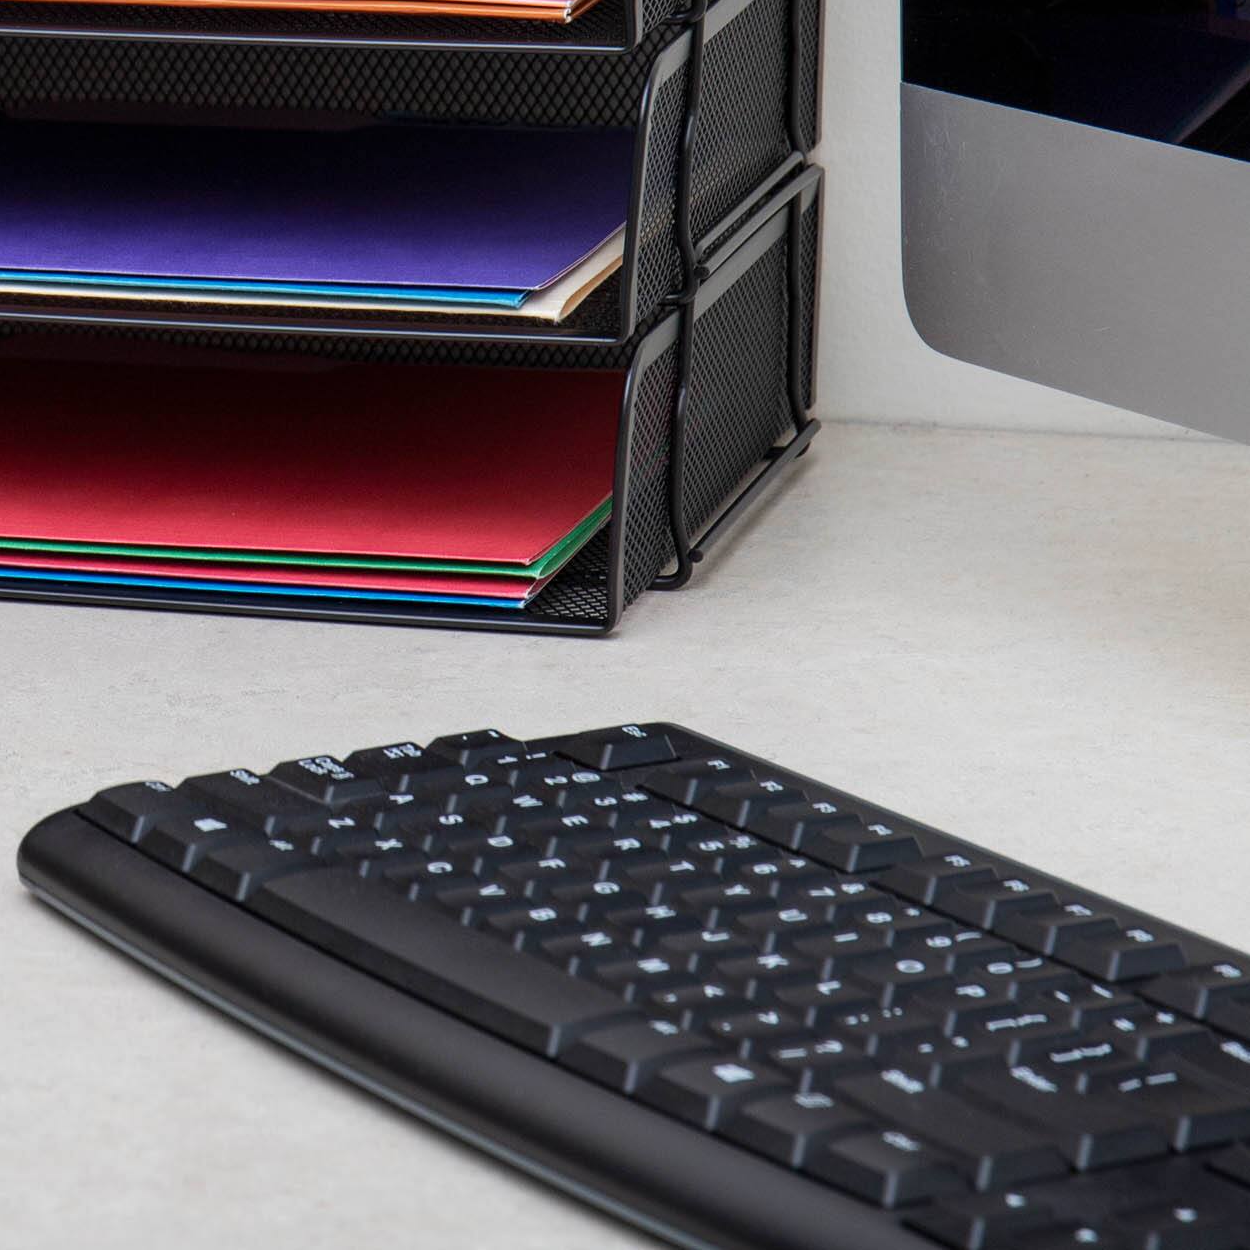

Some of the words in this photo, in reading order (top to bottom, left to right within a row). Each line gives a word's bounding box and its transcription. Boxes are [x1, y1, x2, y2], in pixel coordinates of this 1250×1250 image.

[465, 774, 489, 786] Q
[513, 795, 543, 807] W
[594, 796, 618, 807] 3
[438, 814, 464, 825] S
[561, 815, 589, 827] E
[374, 838, 404, 851] X
[487, 835, 514, 848] D
[613, 838, 641, 851] R
[427, 861, 453, 874] C
[538, 858, 567, 869] F
[669, 860, 696, 872] T
[753, 863, 778, 875] 6
[478, 884, 507, 896] V
[593, 881, 620, 895] G
[701, 931, 730, 943] J
[926, 936, 952, 948] 9
[896, 959, 926, 974] O
[816, 980, 842, 995] L
[955, 984, 987, 998] P
